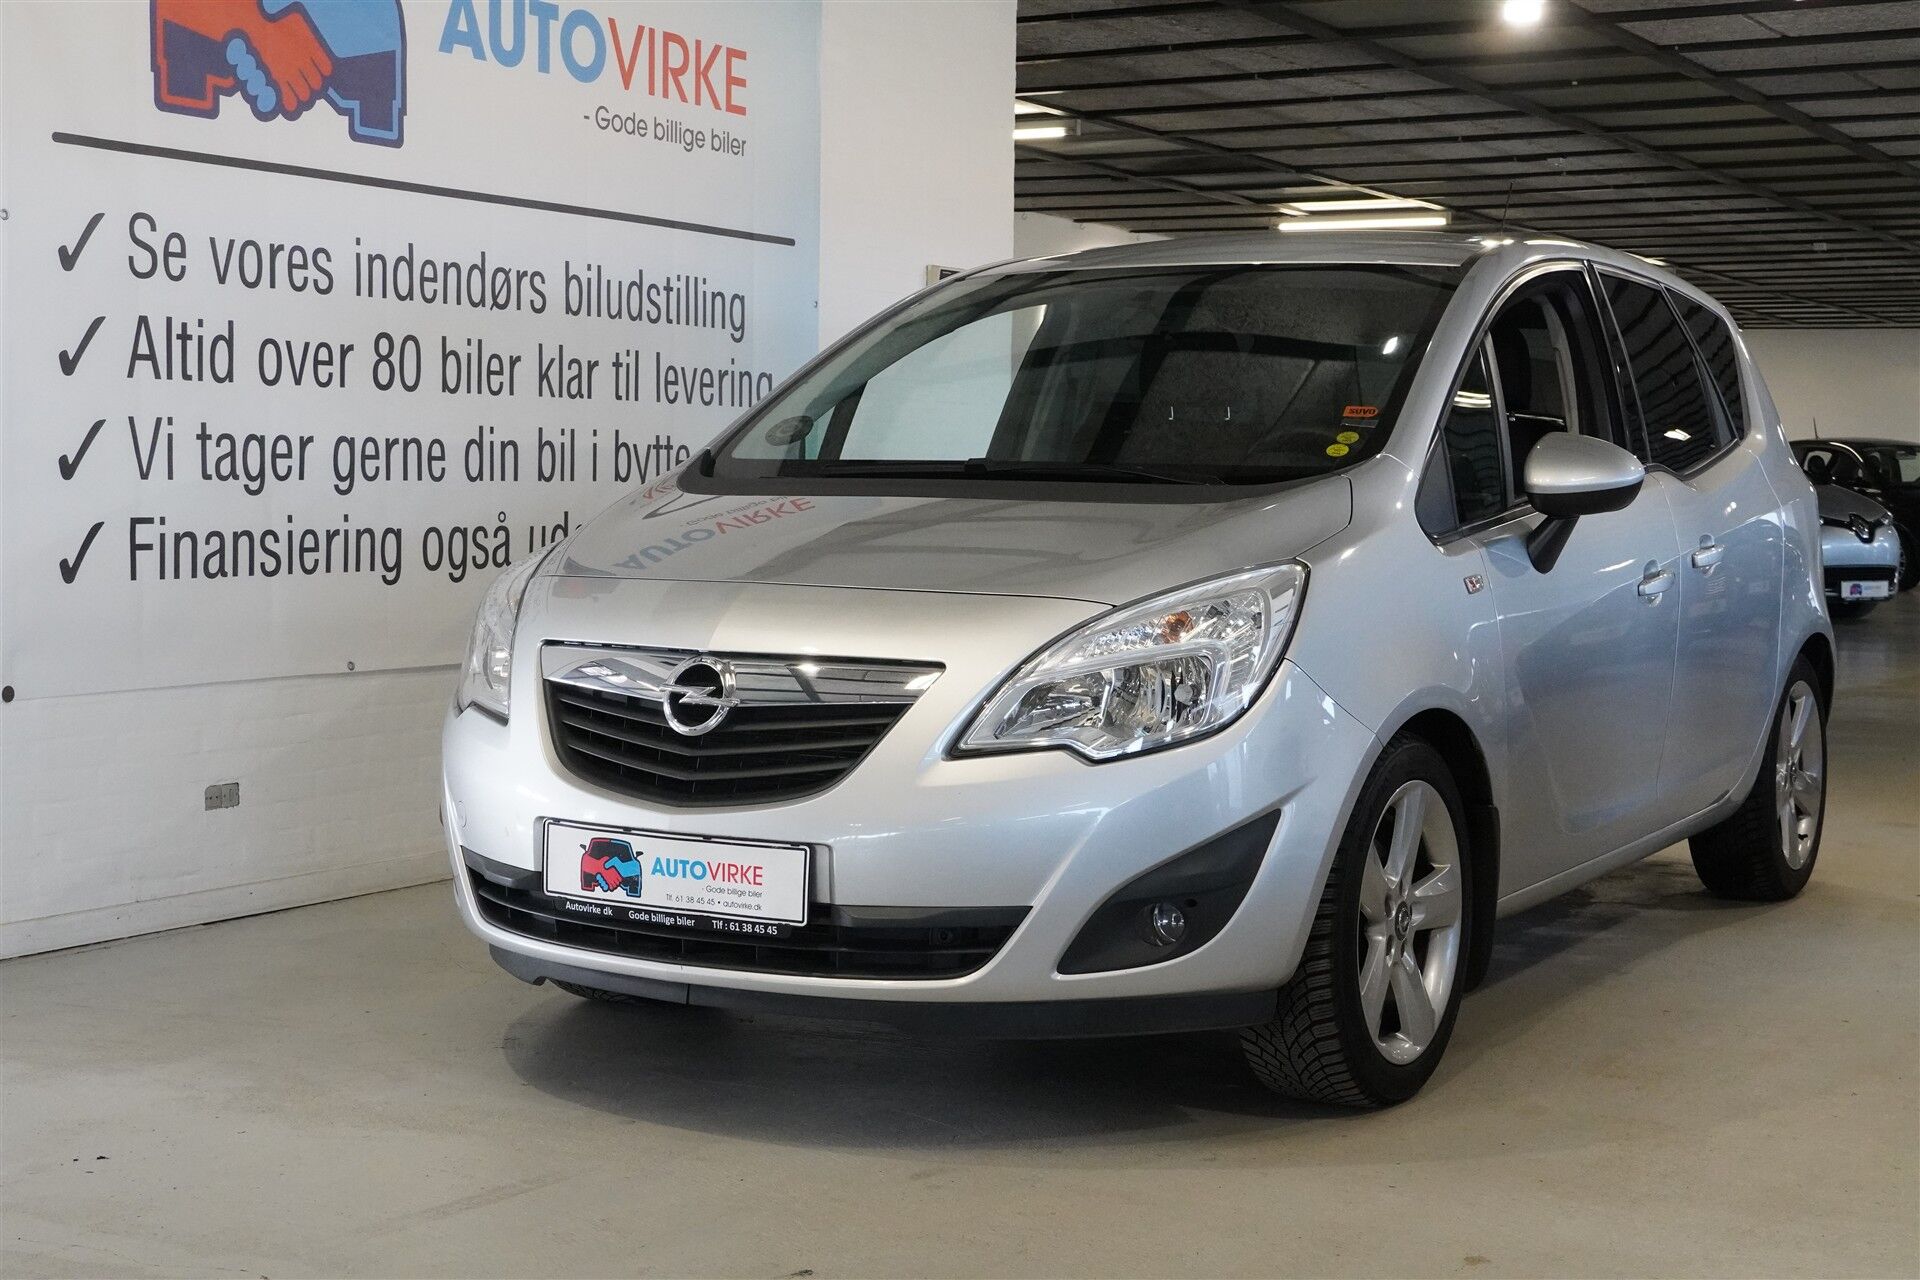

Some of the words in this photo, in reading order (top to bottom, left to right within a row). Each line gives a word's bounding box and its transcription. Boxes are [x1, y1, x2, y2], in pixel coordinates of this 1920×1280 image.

[438, 0, 747, 116] AUTOVIRKE
[595, 105, 648, 137] Gode
[654, 117, 706, 152] billige
[710, 129, 747, 156] biler
[128, 212, 187, 282] Se
[209, 236, 334, 296] vores
[355, 237, 547, 316] indendørs
[565, 260, 746, 344] biludstilling
[127, 315, 234, 384] Altid
[258, 337, 355, 389] over
[372, 331, 422, 393] 80
[441, 336, 522, 397] biler
[538, 343, 600, 400] klar
[612, 349, 640, 402] til
[656, 351, 773, 408] levering
[128, 416, 174, 482] Vi
[196, 421, 314, 497] tager
[332, 435, 446, 496] gerne
[464, 426, 519, 483] din
[537, 426, 575, 483] bil
[592, 429, 598, 482] i
[130, 513, 402, 586] Finansiering
[422, 510, 512, 584] også
[651, 856, 763, 886] AUTOVIRKE
[705, 885, 726, 896] Gode
[727, 887, 747, 899] billige
[747, 889, 763, 898] biler
[565, 900, 601, 914] Autovirke
[628, 910, 650, 921] Gode
[651, 912, 675, 926] billige
[676, 916, 696, 927] biler
[729, 922, 740, 932] 61
[742, 923, 753, 933] 38
[754, 925, 765, 934] 45
[766, 926, 778, 936] 45
[675, 895, 683, 903] 61
[685, 895, 695, 903] 38
[696, 897, 705, 905] 45
[706, 898, 716, 906] 45
[722, 900, 763, 911] autovirke.dk
